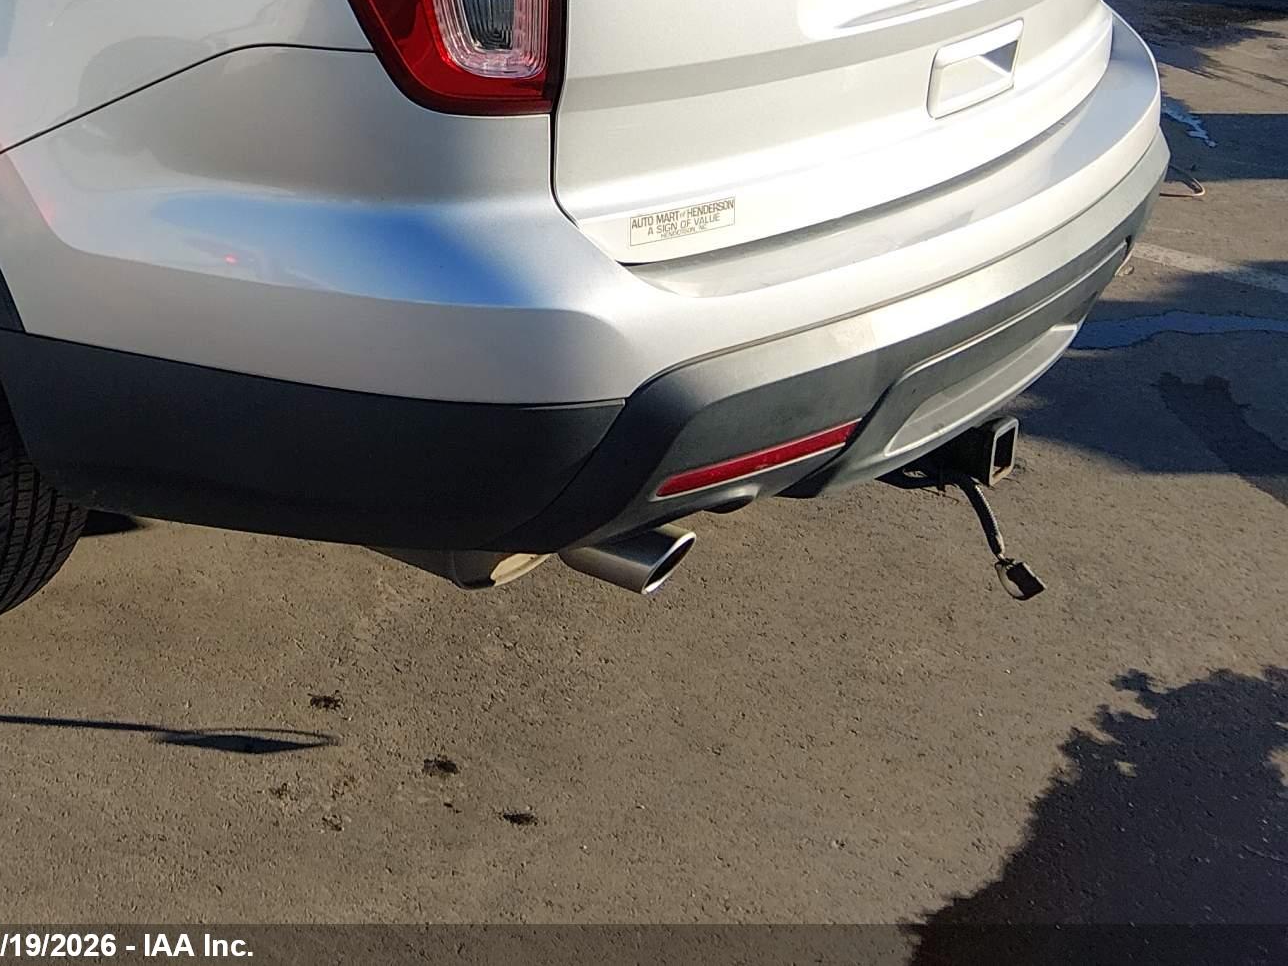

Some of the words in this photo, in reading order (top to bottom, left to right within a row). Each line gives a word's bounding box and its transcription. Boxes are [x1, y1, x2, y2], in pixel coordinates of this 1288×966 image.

[632, 216, 654, 229] AUTO
[656, 211, 680, 223] MART
[687, 200, 734, 218] HENDERSON
[648, 227, 654, 236] A
[656, 222, 678, 234] SIGN
[680, 219, 693, 228] OF
[694, 213, 721, 226] VALUE
